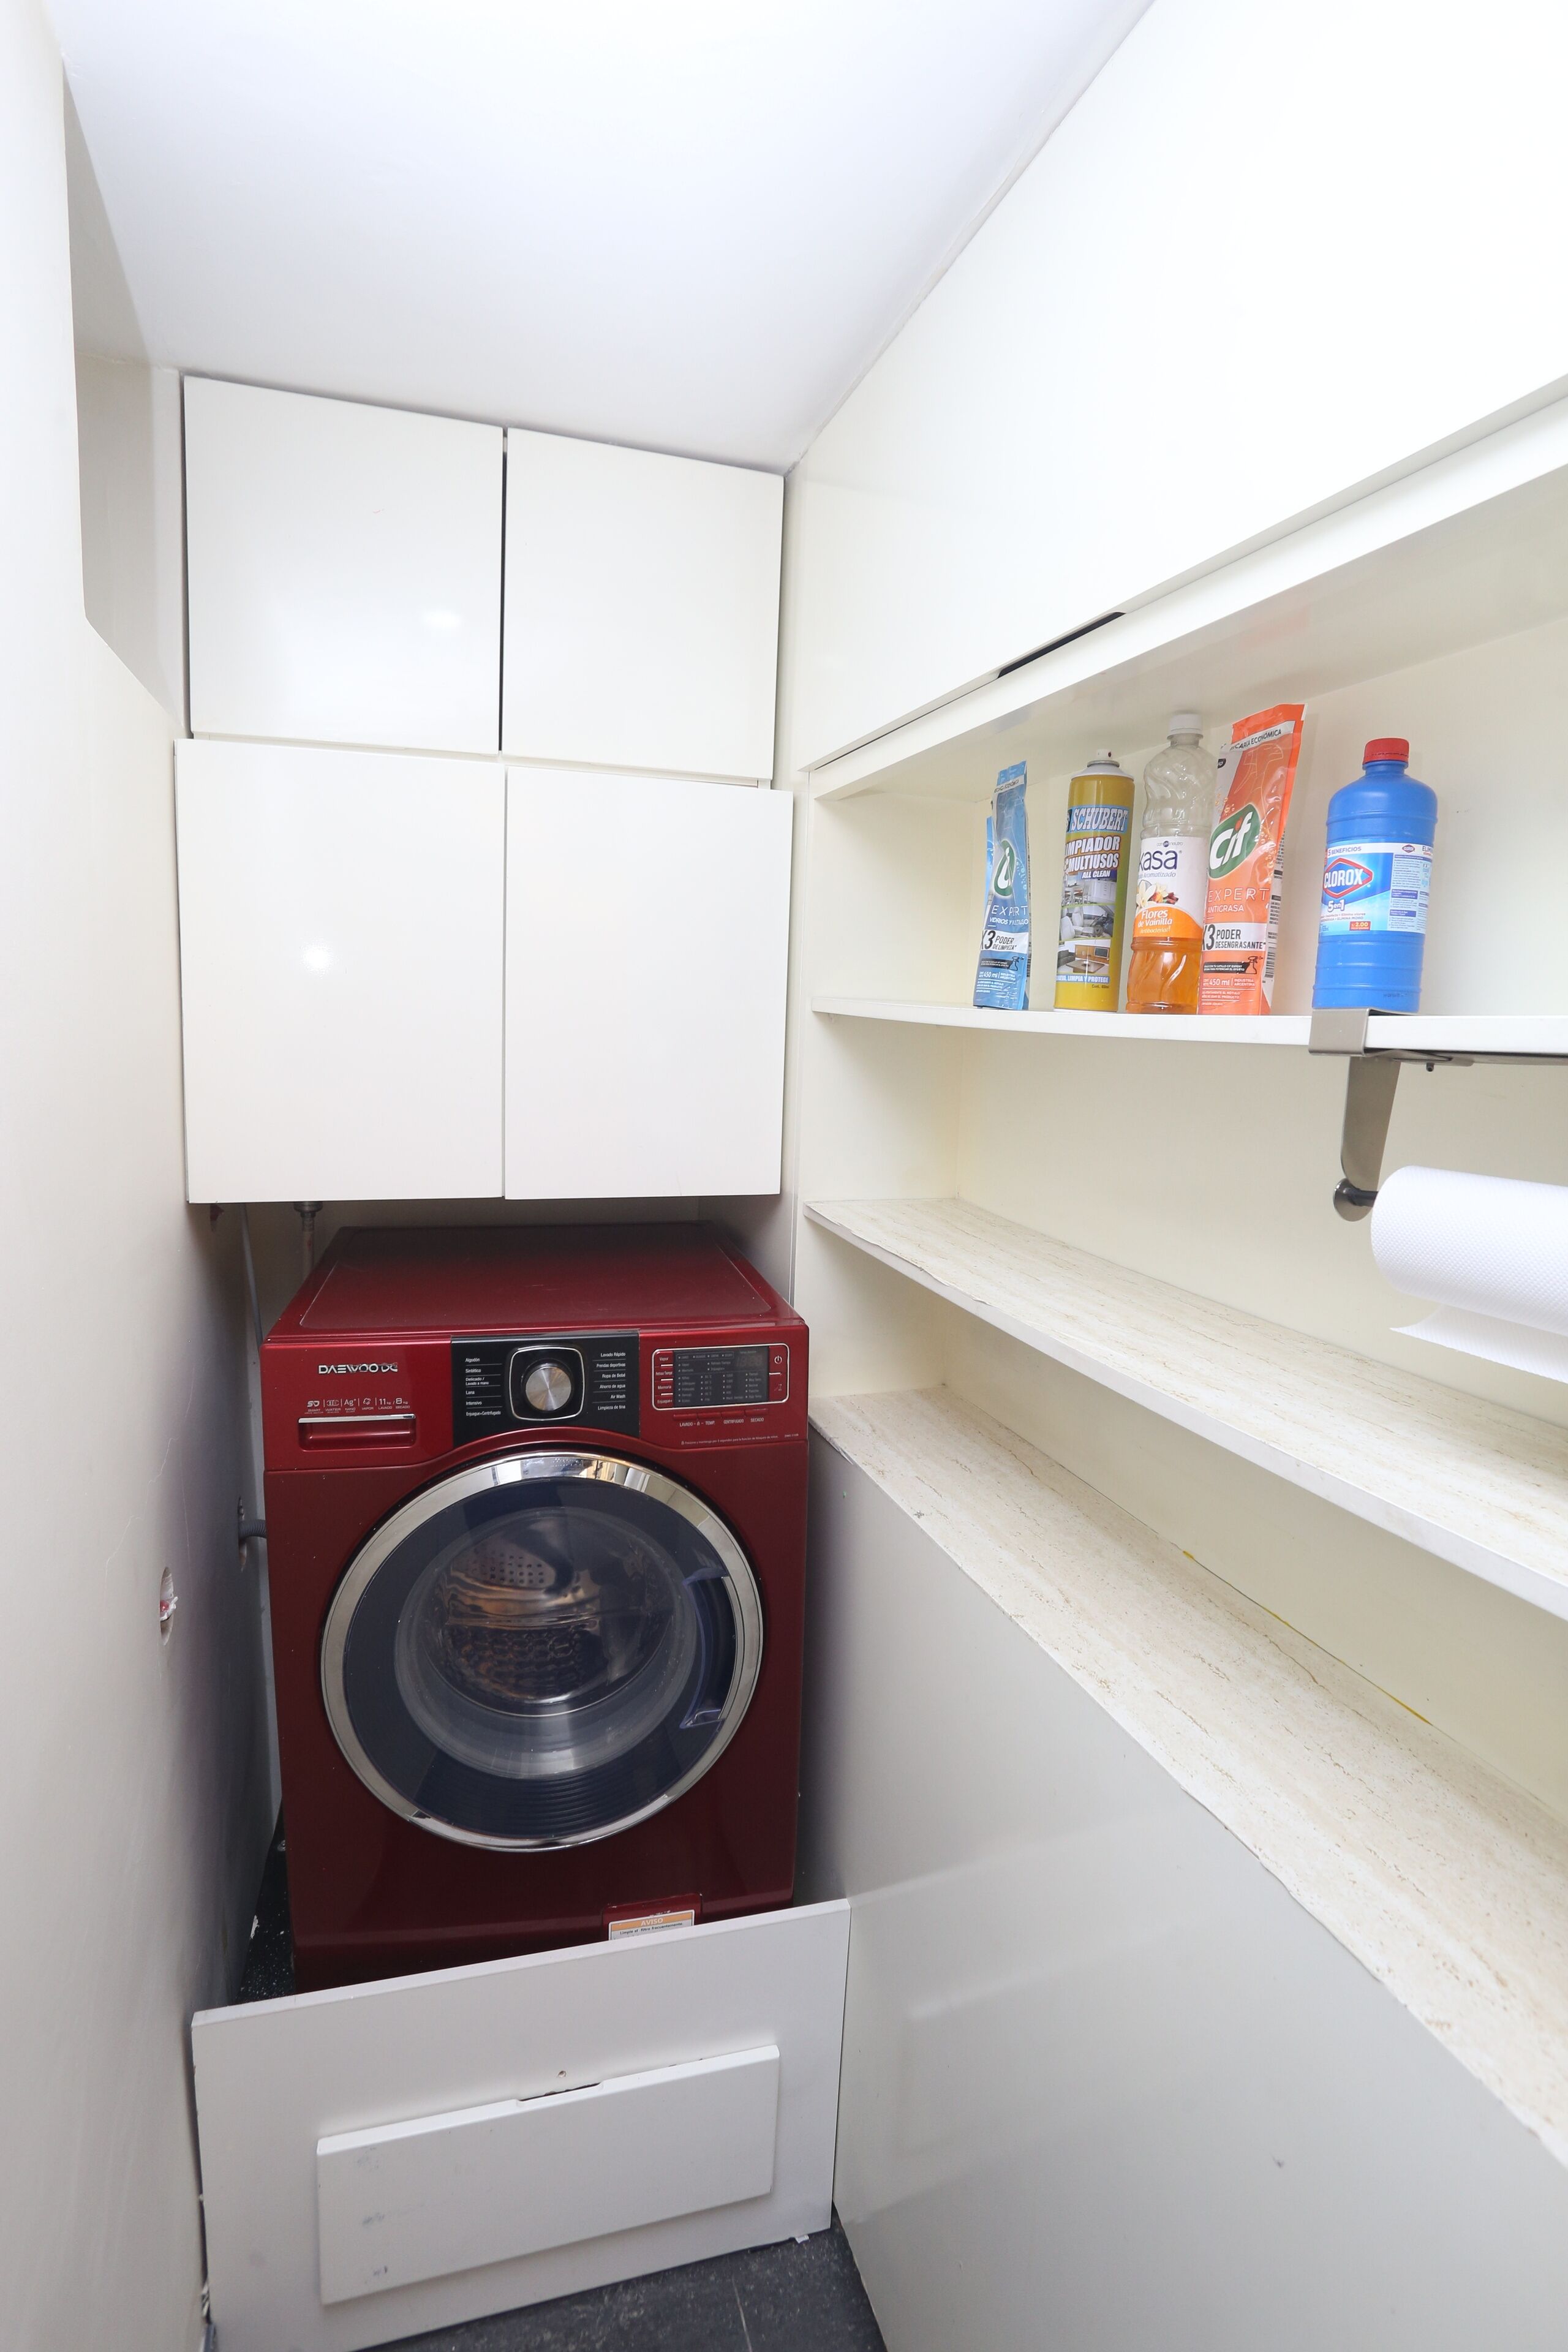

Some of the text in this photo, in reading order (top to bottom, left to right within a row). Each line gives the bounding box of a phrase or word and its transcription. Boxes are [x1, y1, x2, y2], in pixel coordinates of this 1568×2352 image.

[1071, 808, 1128, 831] SCHUBERT
[1066, 836, 1120, 858] IMPIADOR
[1210, 812, 1253, 870] Cif
[1332, 846, 1362, 855] BENEFICIOS
[1068, 853, 1119, 873] MULTIUSOS
[1324, 869, 1363, 889] CLOROX
[1208, 888, 1270, 903] EXPERT
[1141, 910, 1168, 919] Flores
[1208, 904, 1245, 913] ANTIGRASA
[995, 935, 1015, 944] PODER
[1216, 929, 1242, 940] PODER
[641, 1918, 663, 1926] AVISO
